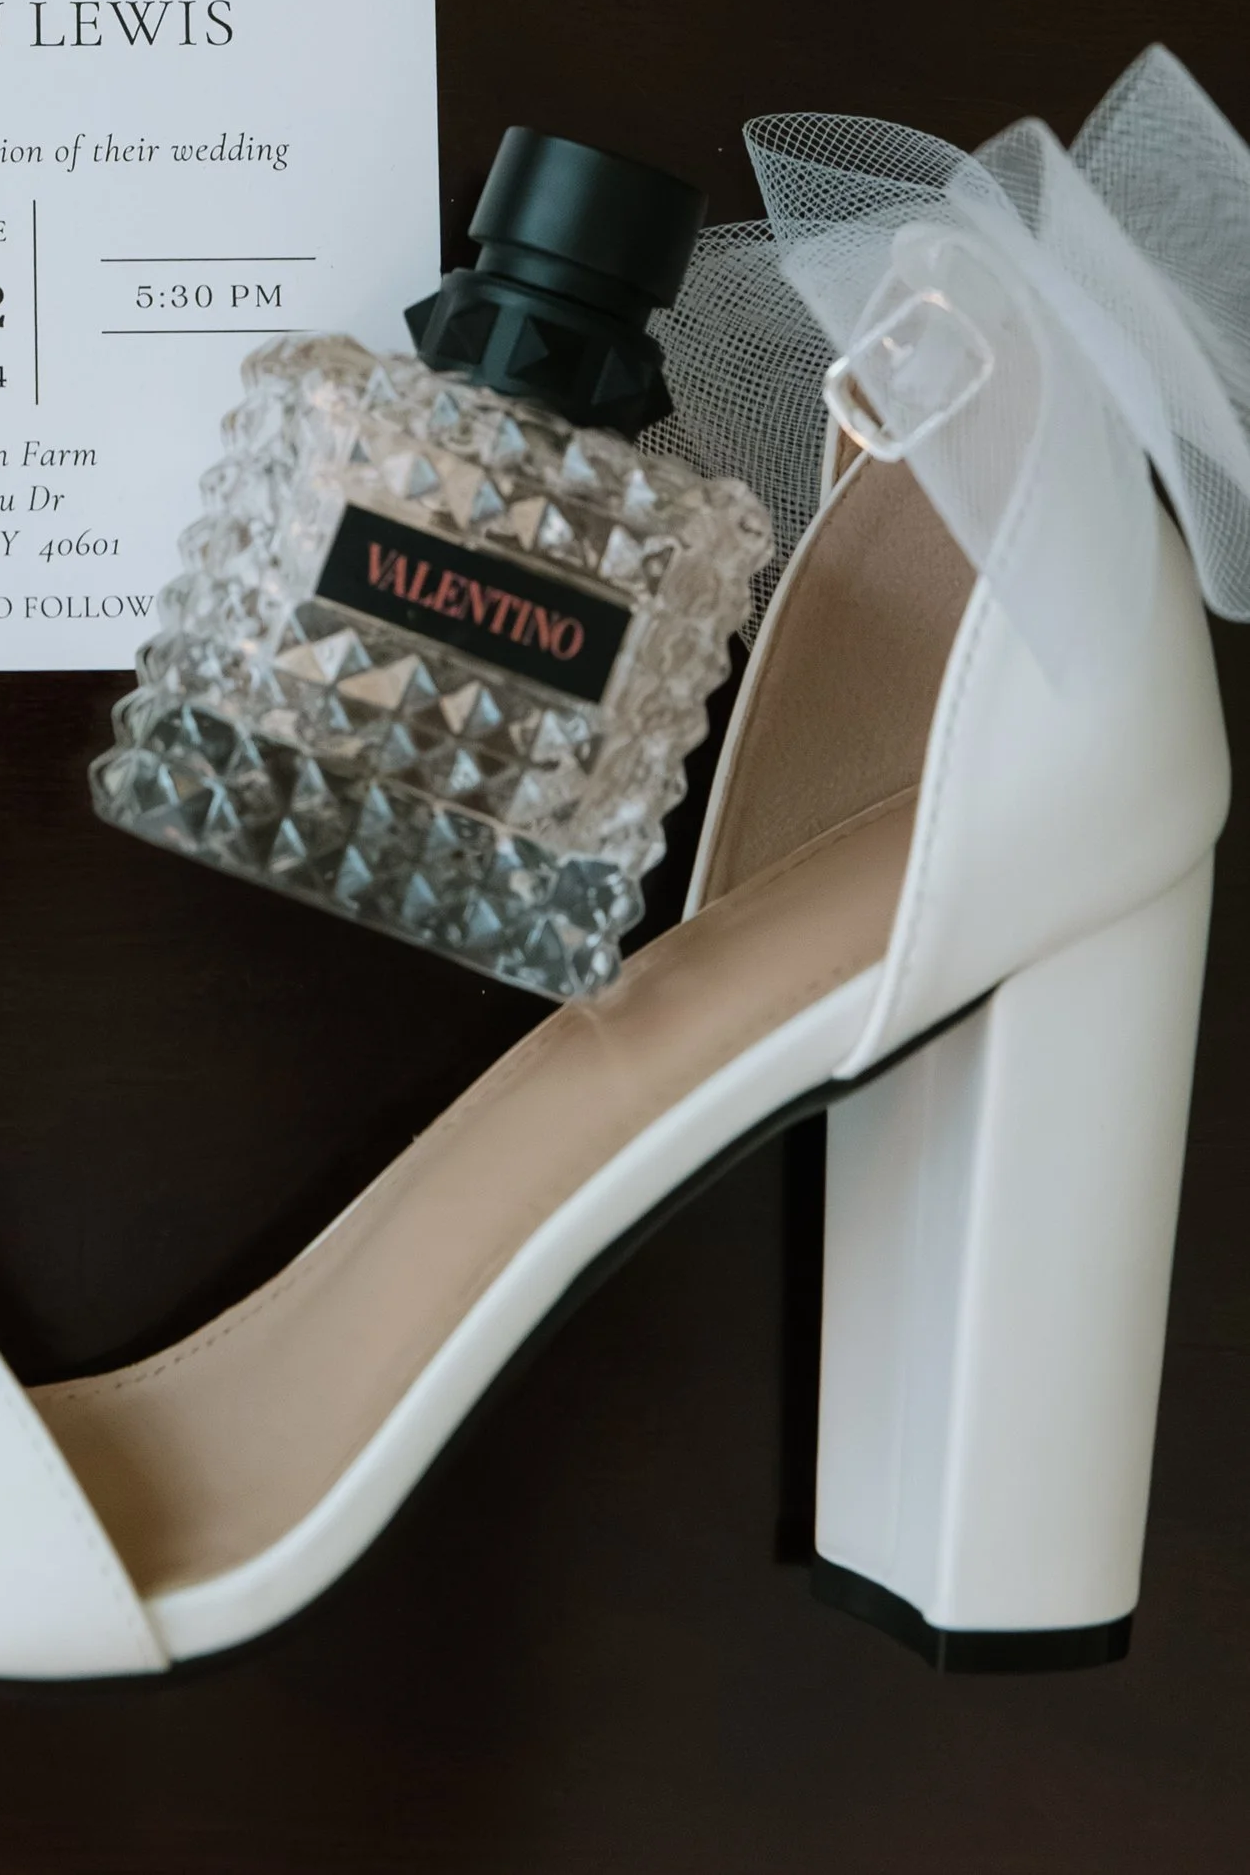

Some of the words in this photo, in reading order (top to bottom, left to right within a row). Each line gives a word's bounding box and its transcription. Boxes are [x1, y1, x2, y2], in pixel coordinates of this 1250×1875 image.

[29, 0, 235, 47] LEWIS
[54, 132, 86, 173] of
[92, 132, 160, 163] their
[170, 131, 291, 172] wedding
[135, 284, 213, 309] 5:30
[230, 284, 283, 308] PM
[21, 440, 98, 467] Farm
[28, 485, 66, 512] Dr
[38, 534, 120, 563] 40601
[25, 594, 155, 619] FOLLOW
[366, 541, 585, 662] VALENTINO
